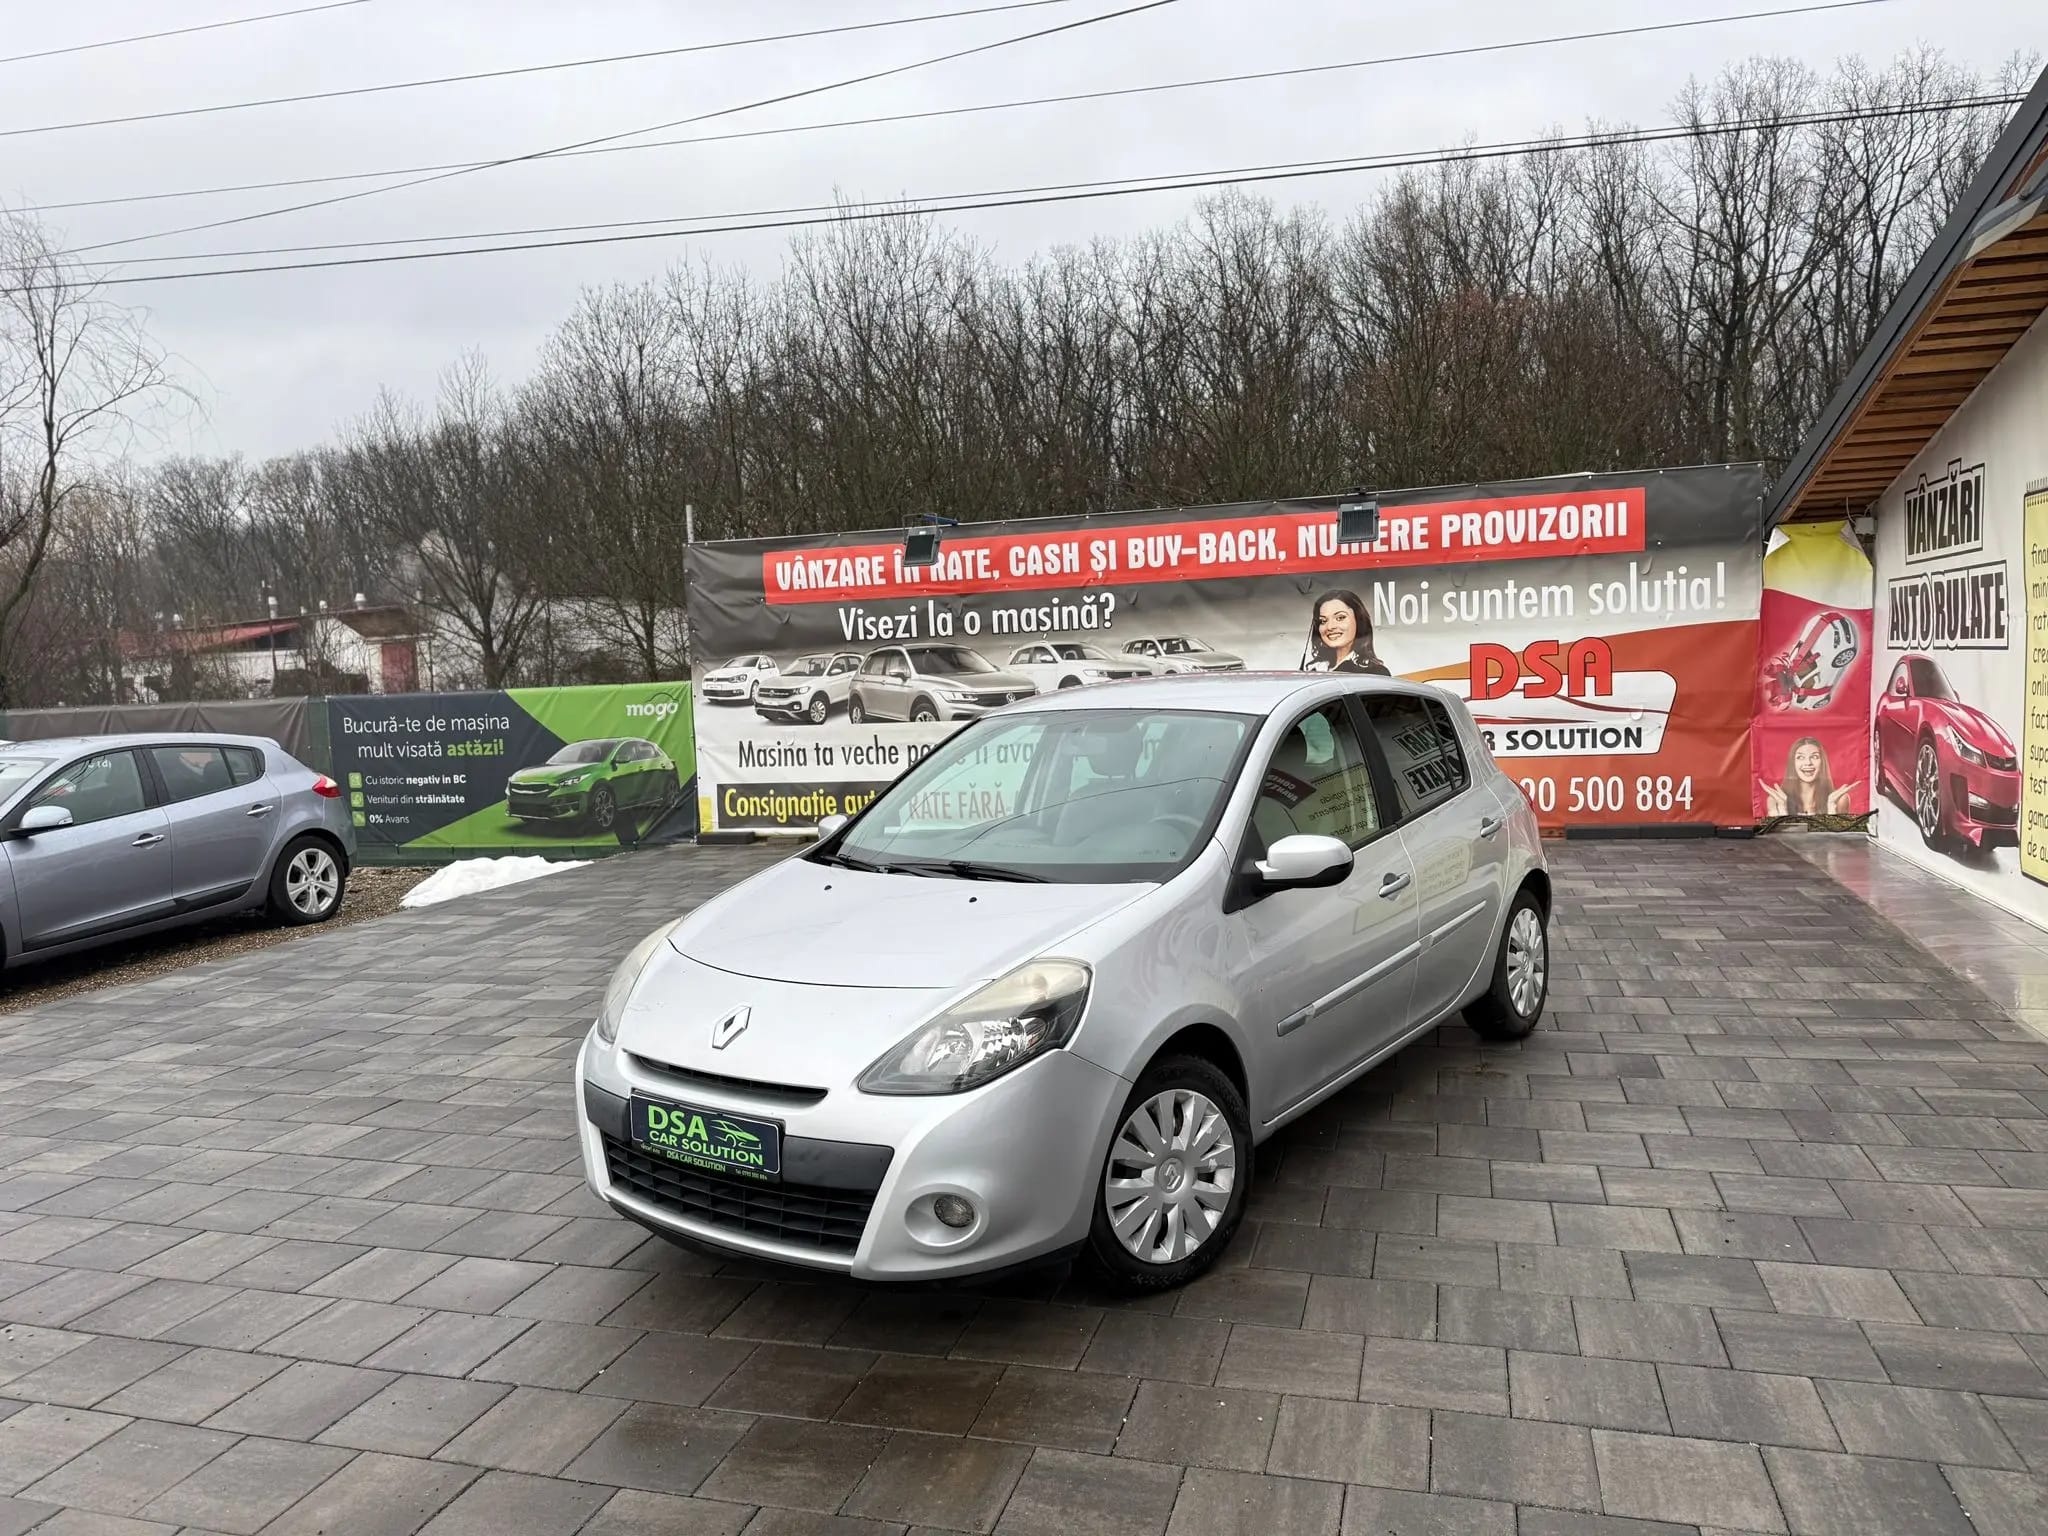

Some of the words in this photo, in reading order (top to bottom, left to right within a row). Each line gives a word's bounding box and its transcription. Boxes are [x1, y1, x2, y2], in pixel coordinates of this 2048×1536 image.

[1906, 469, 1981, 556] VÂNZĂRI
[775, 555, 886, 590] VÂNZARE
[930, 548, 999, 581] RATE,
[1009, 542, 1080, 577] CASH
[1089, 539, 1117, 579] ȘI
[1441, 501, 1627, 549] PROVIZORII
[1373, 580, 1429, 627] Noi
[1442, 579, 1574, 623] suntem
[1589, 561, 1725, 621] soluția!
[838, 605, 918, 641] Visezi
[928, 599, 953, 637] la
[963, 609, 982, 636] o
[992, 592, 1116, 640] mașină?
[1470, 636, 1613, 700] DSA
[343, 715, 421, 734] Bucură-te
[425, 714, 446, 731] de
[451, 713, 510, 734] mașina
[625, 702, 679, 721] mogo
[358, 741, 394, 758] mult
[396, 741, 442, 758] visată
[447, 738, 504, 757] astăzi!
[814, 741, 834, 765] ta
[842, 734, 899, 765] veche
[1506, 726, 1642, 751] SOLUTION
[365, 775, 378, 786] Cu
[380, 775, 404, 785] istoric
[406, 775, 440, 787] negativ
[453, 774, 467, 784] BC
[1568, 775, 1624, 812] 500
[1636, 774, 1693, 811] 884
[367, 795, 399, 805] Venituri
[401, 794, 414, 804] din
[415, 794, 465, 804] străinătate
[724, 788, 837, 823] Consignație
[369, 814, 384, 824] 0%
[385, 814, 410, 824] Avans
[648, 1104, 709, 1142] DSA
[649, 1130, 678, 1147] CAR
[682, 1138, 763, 1166] SOLUTION
[693, 1157, 726, 1173] SOLUTION
